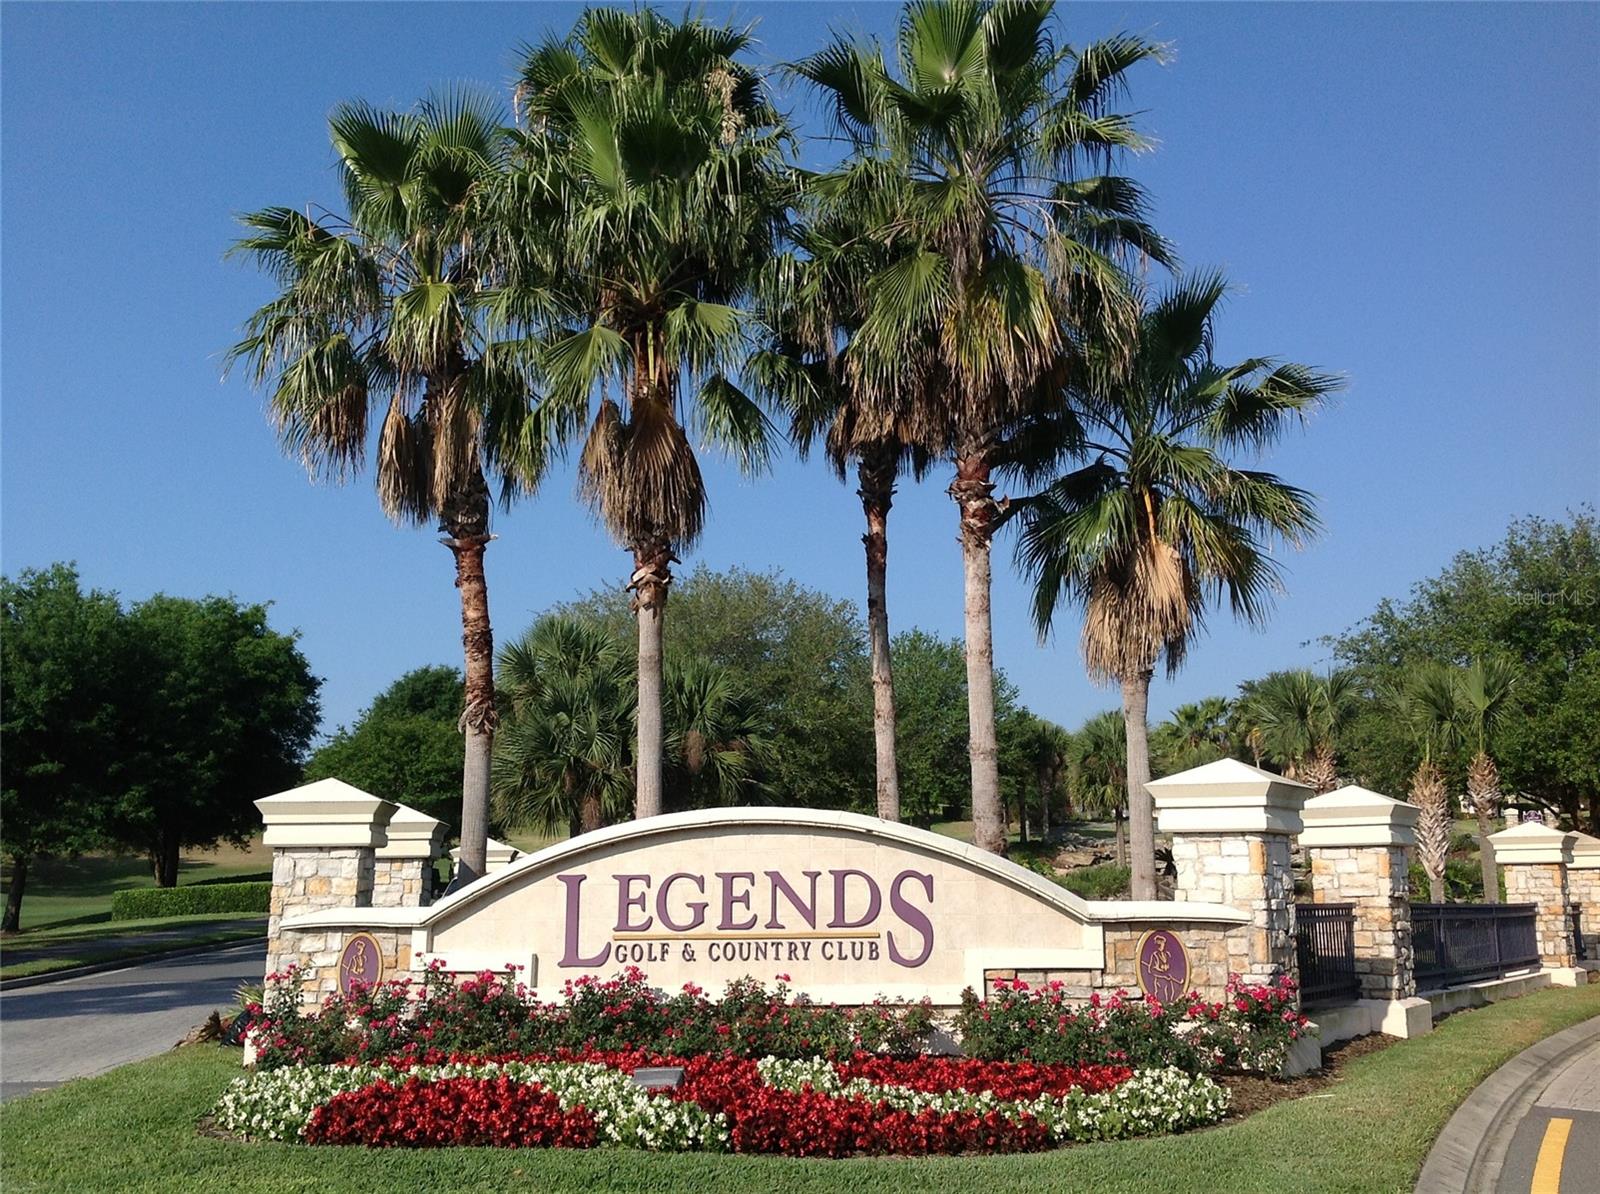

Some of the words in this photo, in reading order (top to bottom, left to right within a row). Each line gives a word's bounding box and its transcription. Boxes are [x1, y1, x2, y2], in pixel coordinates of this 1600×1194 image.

[557, 869, 934, 968] LEGENDS
[614, 942, 670, 963] GOLF
[681, 942, 697, 962] &
[708, 941, 811, 962] COUNTRY
[821, 940, 880, 961] CLUB
